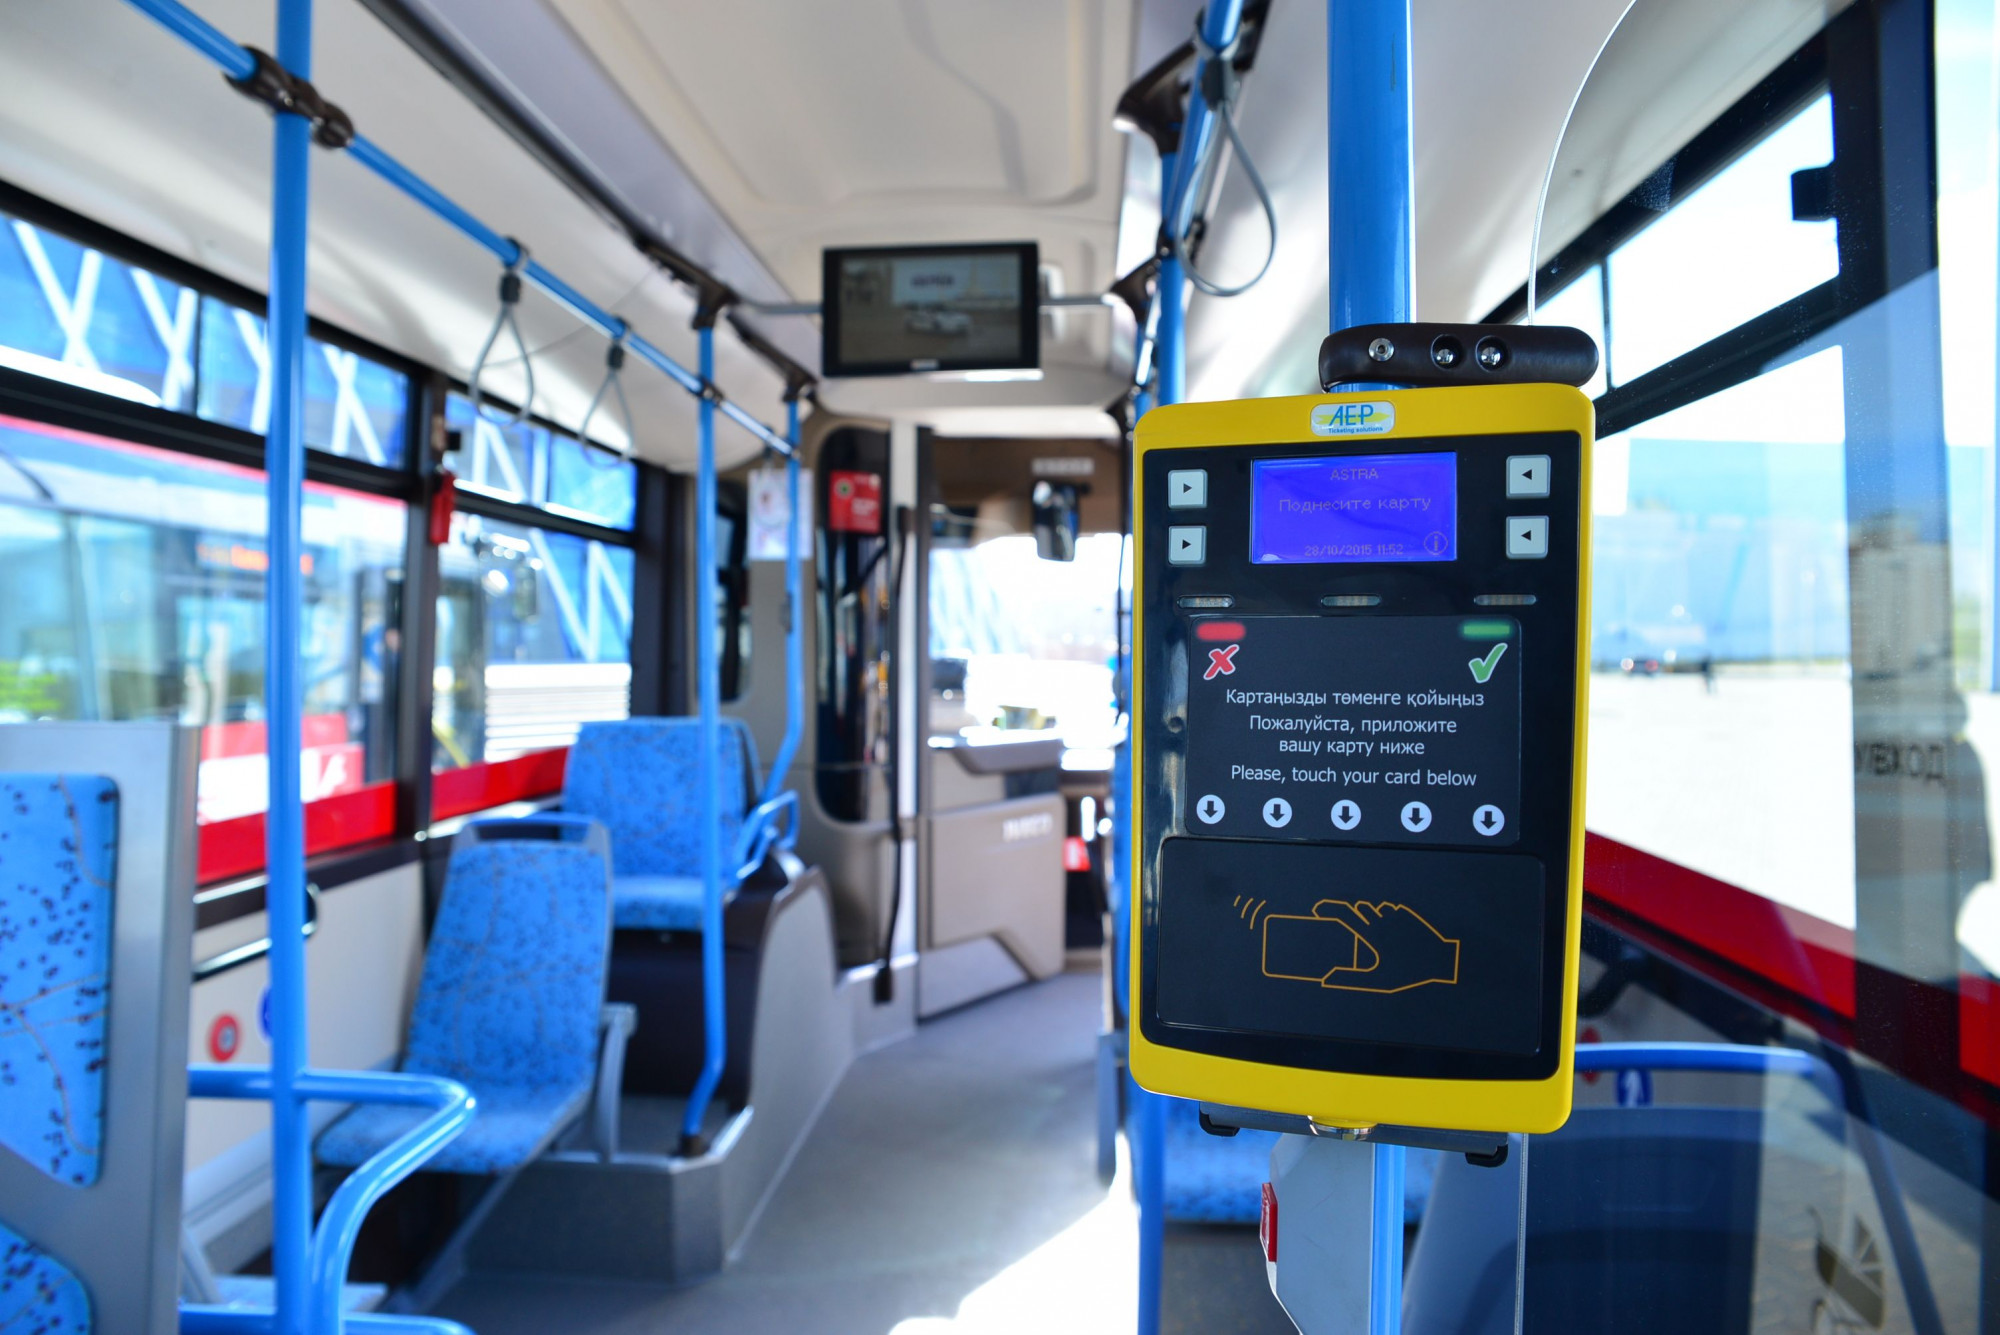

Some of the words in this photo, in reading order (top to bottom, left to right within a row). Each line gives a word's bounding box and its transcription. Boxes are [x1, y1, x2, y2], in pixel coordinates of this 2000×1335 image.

[1328, 404, 1374, 426] AEP
[1328, 426, 1355, 434] Ticketing
[1330, 468, 1378, 480] ASTRA
[1279, 499, 1372, 513] Поднесите
[1378, 498, 1431, 511] карту
[1304, 545, 1372, 556] 28/10/2015
[1377, 544, 1404, 555] 11:52
[1226, 689, 1326, 707] Картаңызды
[1332, 692, 1401, 705] төменге
[1407, 689, 1484, 708] қойыңыз
[1250, 715, 1355, 734] Пожалуйста,
[1361, 719, 1457, 735] приложите
[1279, 740, 1321, 755] вашу
[1327, 741, 1374, 757] карту
[1380, 742, 1425, 754] ниже
[1231, 765, 1286, 784] Please,
[1292, 767, 1337, 782] touch
[1342, 770, 1379, 786] your
[1384, 769, 1421, 785] card
[1427, 769, 1477, 786] below
